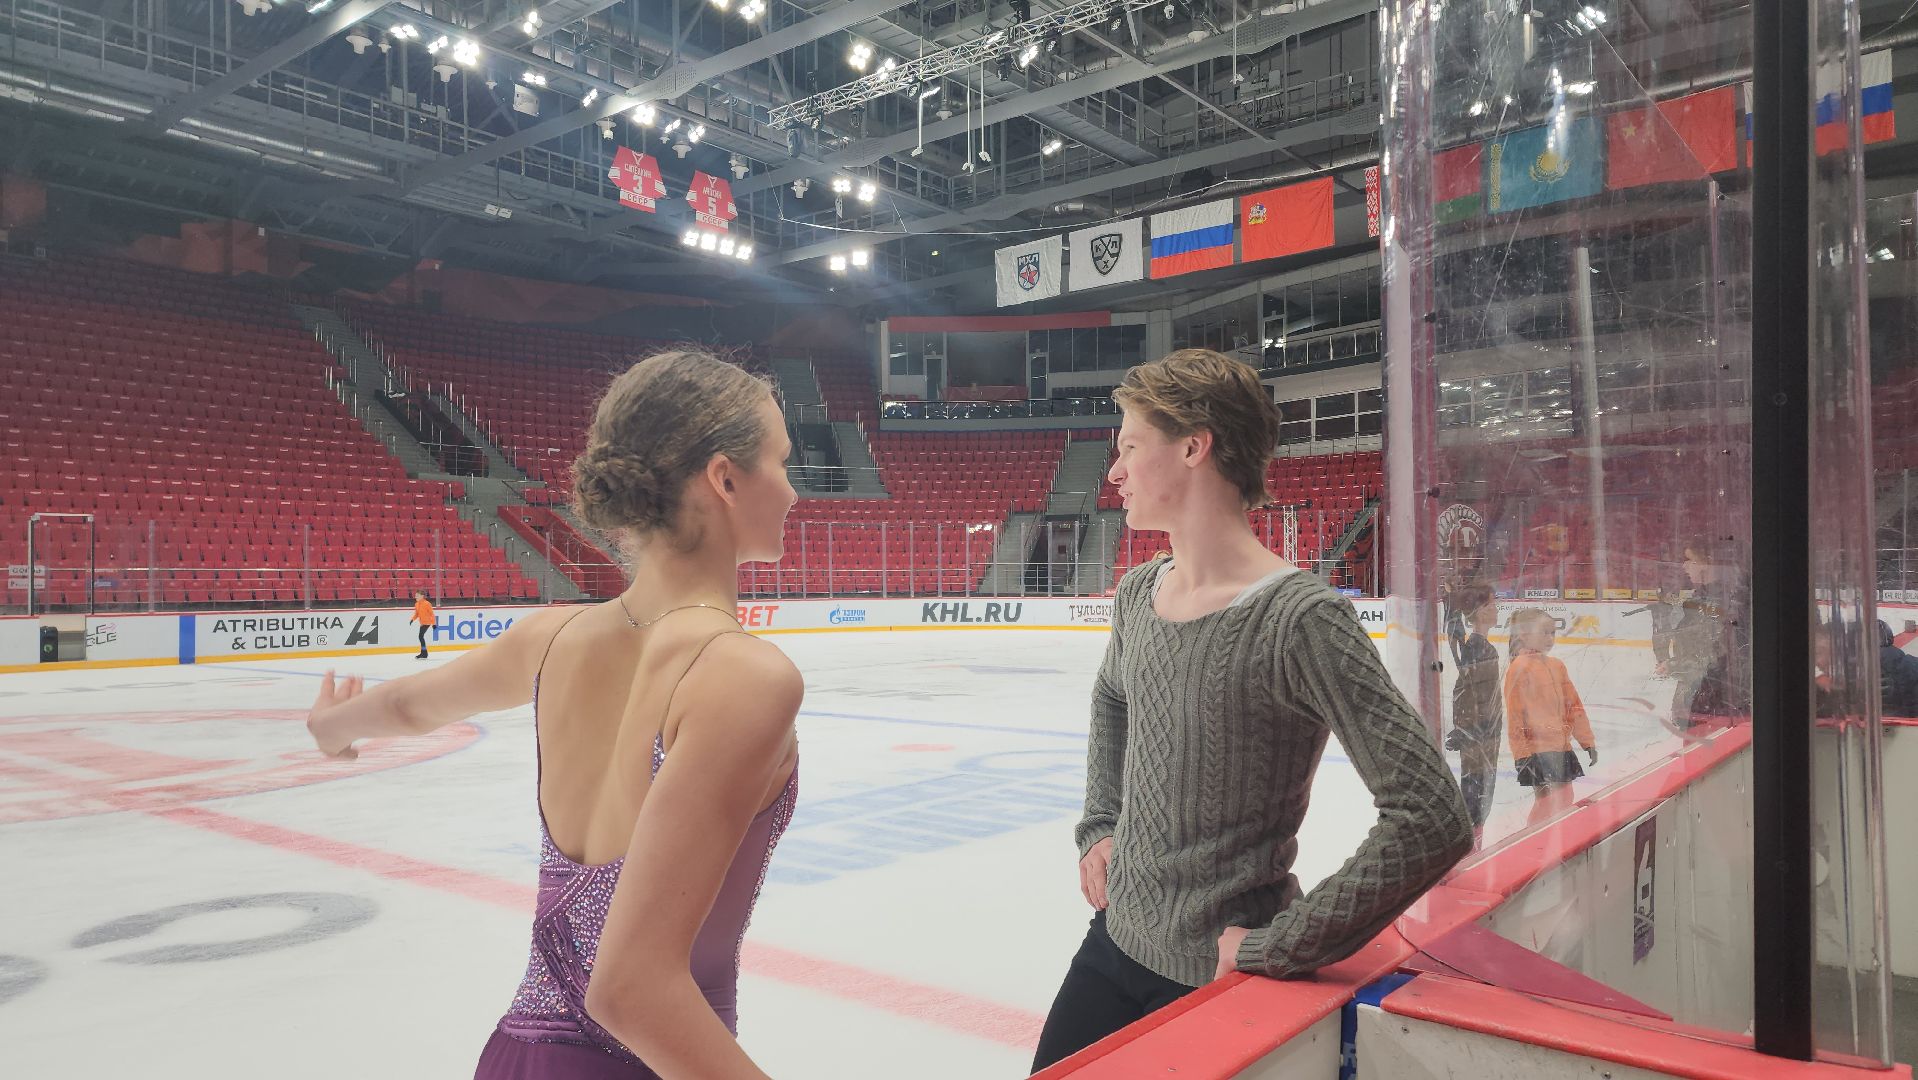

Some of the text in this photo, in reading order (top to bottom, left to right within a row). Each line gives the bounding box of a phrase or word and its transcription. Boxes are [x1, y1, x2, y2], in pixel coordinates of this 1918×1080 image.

[633, 175, 643, 194] 3
[627, 192, 649, 205] СССР
[708, 196, 717, 216] 5
[1018, 253, 1039, 266] МХЛ
[921, 602, 1023, 623] KHL.RU
[212, 616, 344, 633] ATRIBUTIKA
[231, 637, 246, 650] &
[254, 635, 310, 649] CLUB
